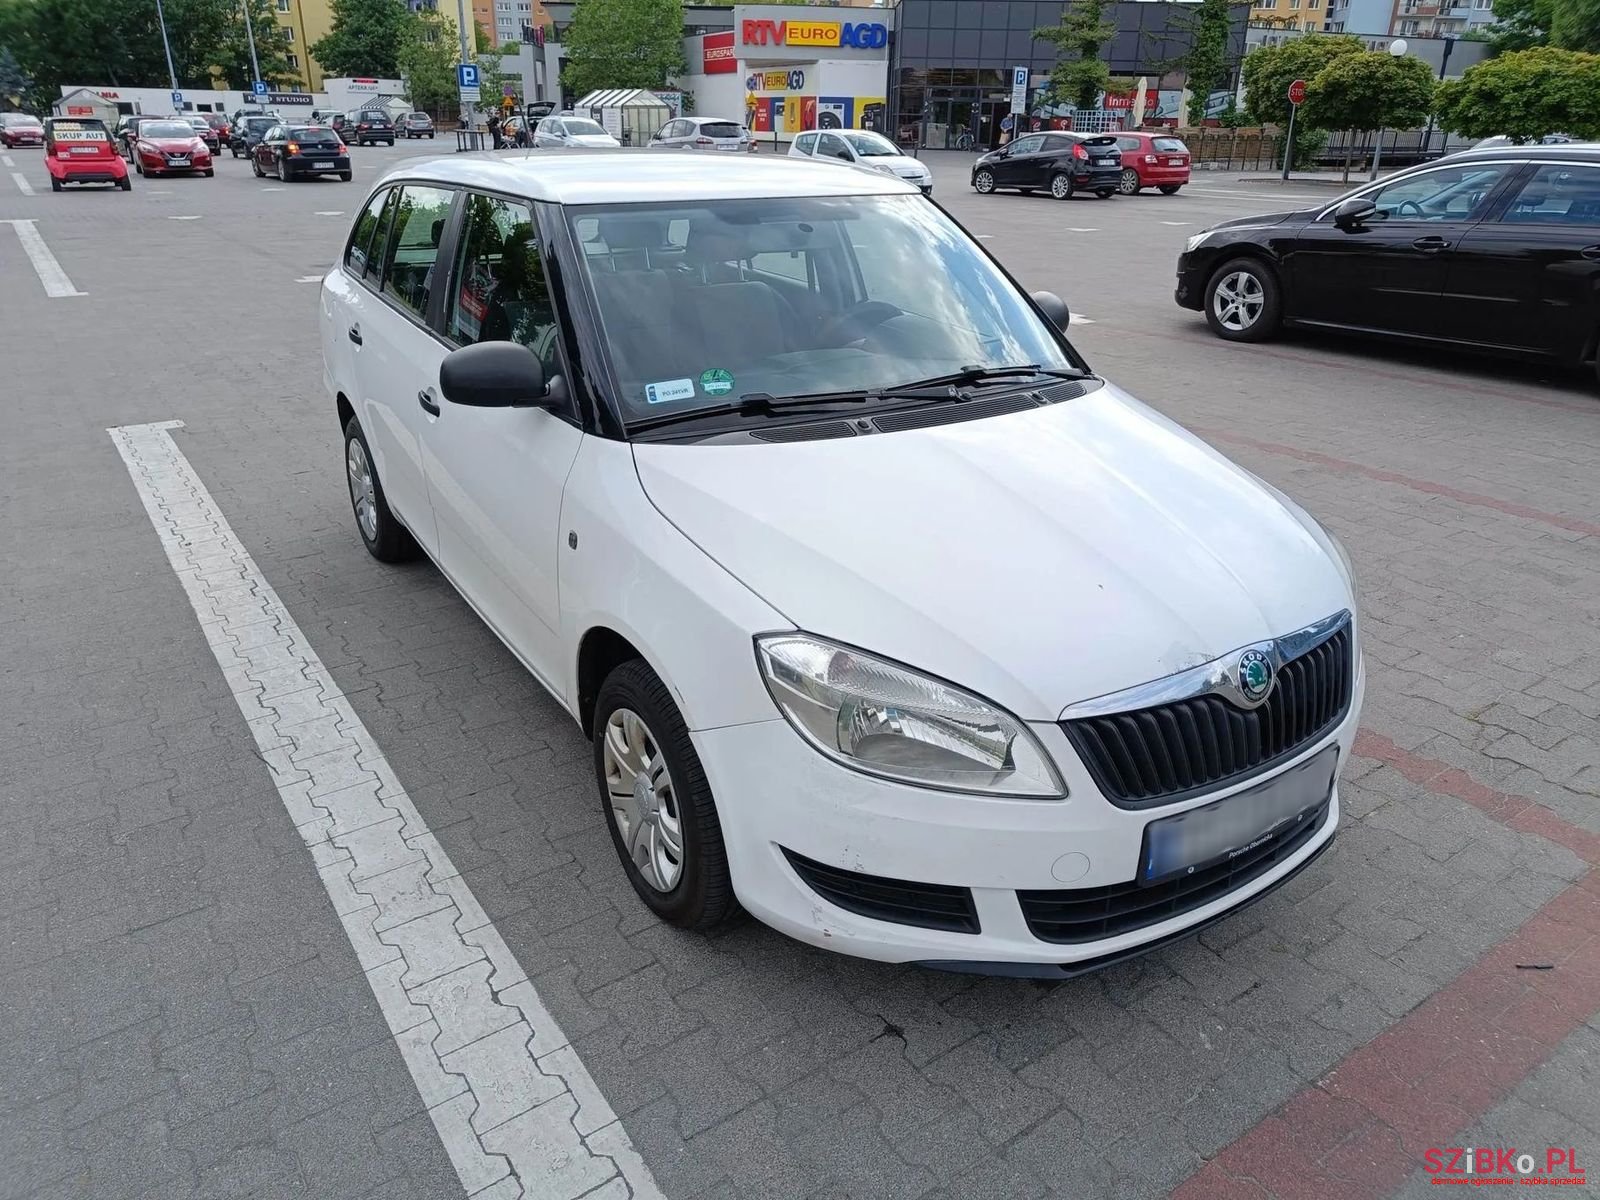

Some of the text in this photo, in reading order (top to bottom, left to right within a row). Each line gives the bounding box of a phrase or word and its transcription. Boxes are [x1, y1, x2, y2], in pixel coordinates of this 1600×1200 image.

[742, 19, 887, 49] RTV EURO AGD
[462, 66, 475, 85] P
[767, 75, 786, 86] EURO
[786, 70, 805, 90] AGD
[1017, 71, 1025, 83] P
[255, 83, 265, 94] P
[85, 132, 105, 140] AUT
[1228, 846, 1249, 859] Porsche
